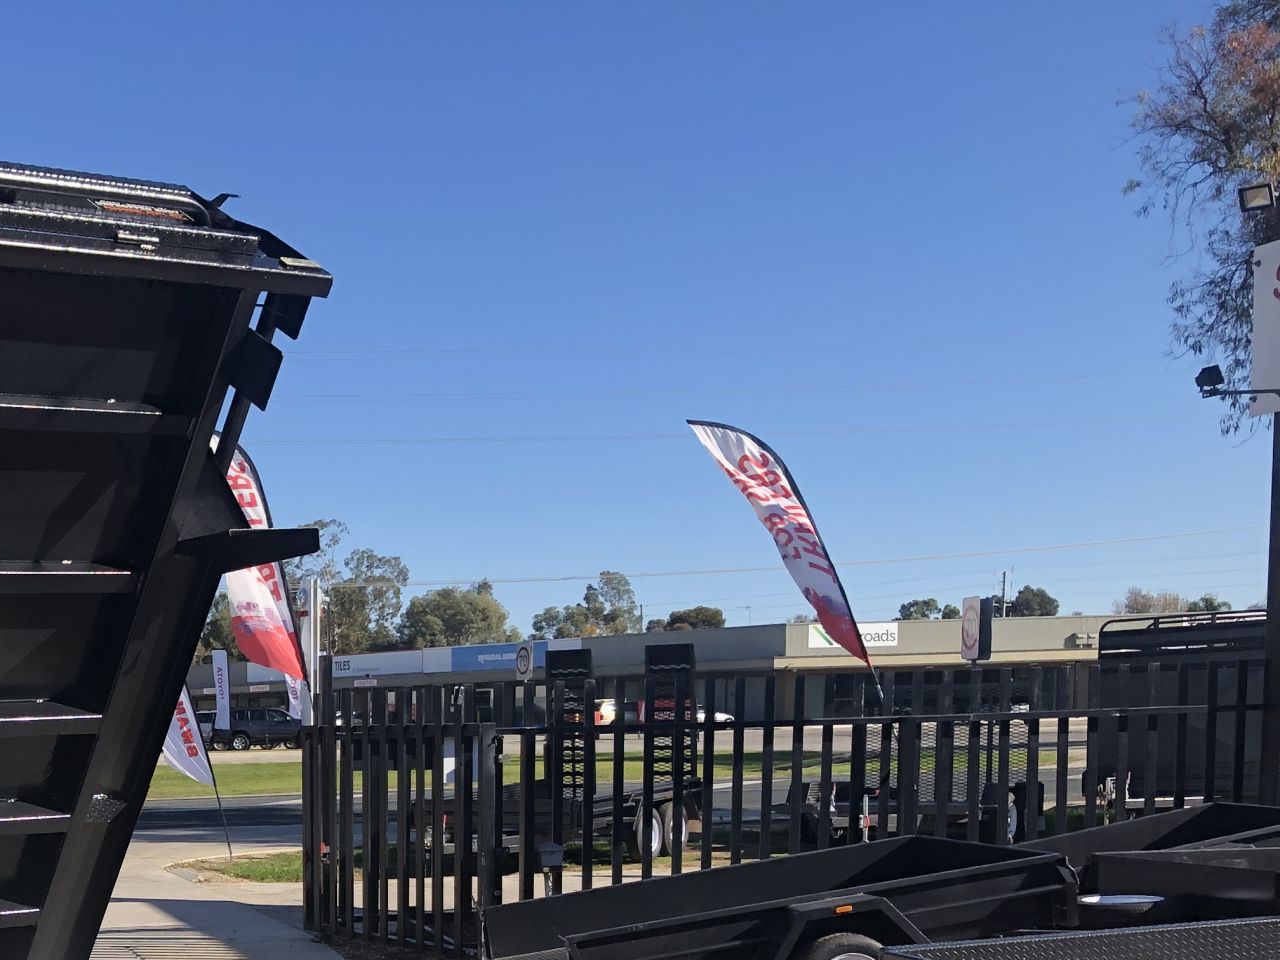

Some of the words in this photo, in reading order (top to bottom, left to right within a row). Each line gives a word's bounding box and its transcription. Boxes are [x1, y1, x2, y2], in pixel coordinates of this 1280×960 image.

[861, 630, 896, 642] roads
[334, 660, 351, 671] TILES
[518, 655, 528, 667] 70
